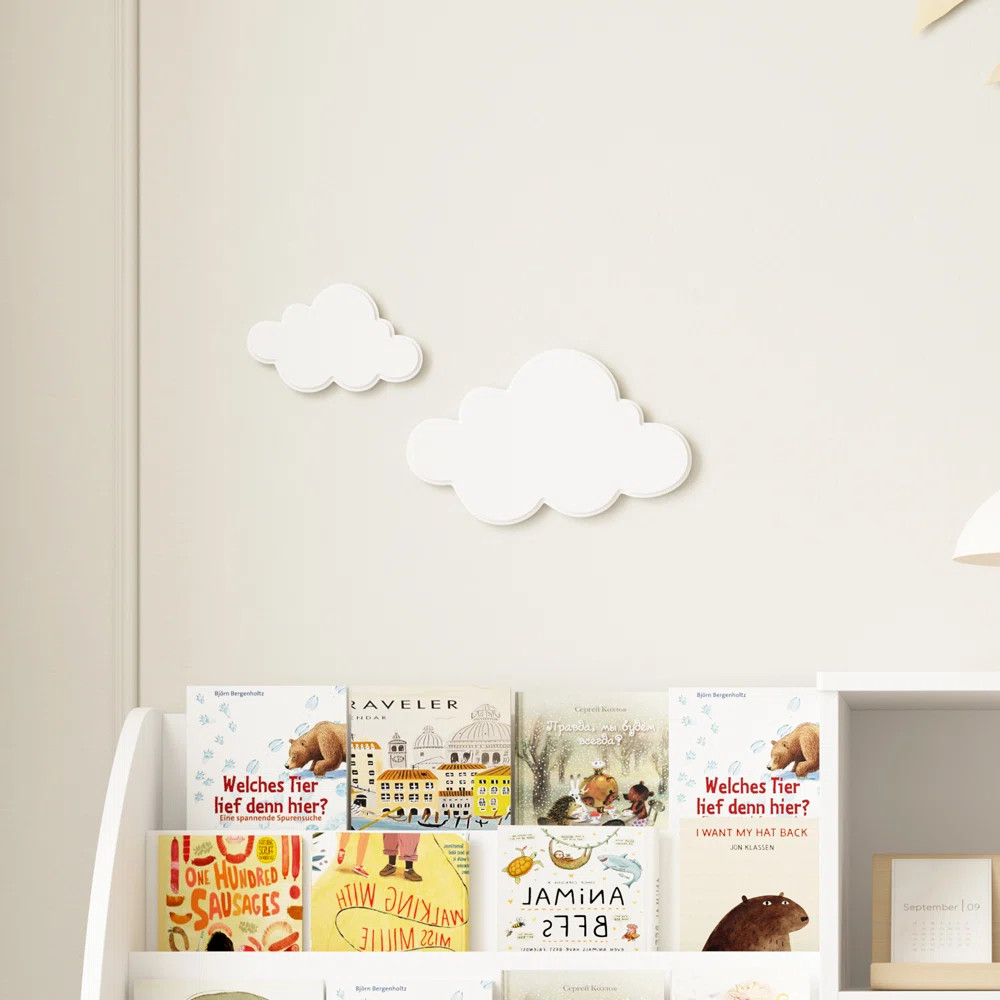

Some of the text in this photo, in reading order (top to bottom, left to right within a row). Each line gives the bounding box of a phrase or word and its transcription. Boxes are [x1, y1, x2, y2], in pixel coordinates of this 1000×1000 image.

[600, 723, 617, 732] мы
[621, 720, 657, 737] будем
[579, 732, 623, 746] всегда?
[222, 775, 319, 793] Welches Tier
[705, 776, 801, 794] Welches Tier
[214, 796, 328, 815] lief denn hier?
[696, 797, 810, 816] lief denn hier?
[236, 814, 275, 823] spannende
[276, 814, 322, 823] Spurensuche
[701, 828, 733, 837] WANT
[736, 828, 753, 837] MY
[755, 828, 777, 837] HAT
[780, 828, 808, 837] BACK
[185, 860, 278, 890] ONE HUNDRED
[190, 887, 280, 931] SAUSAGES
[903, 902, 959, 913] September
[966, 903, 981, 911] 09
